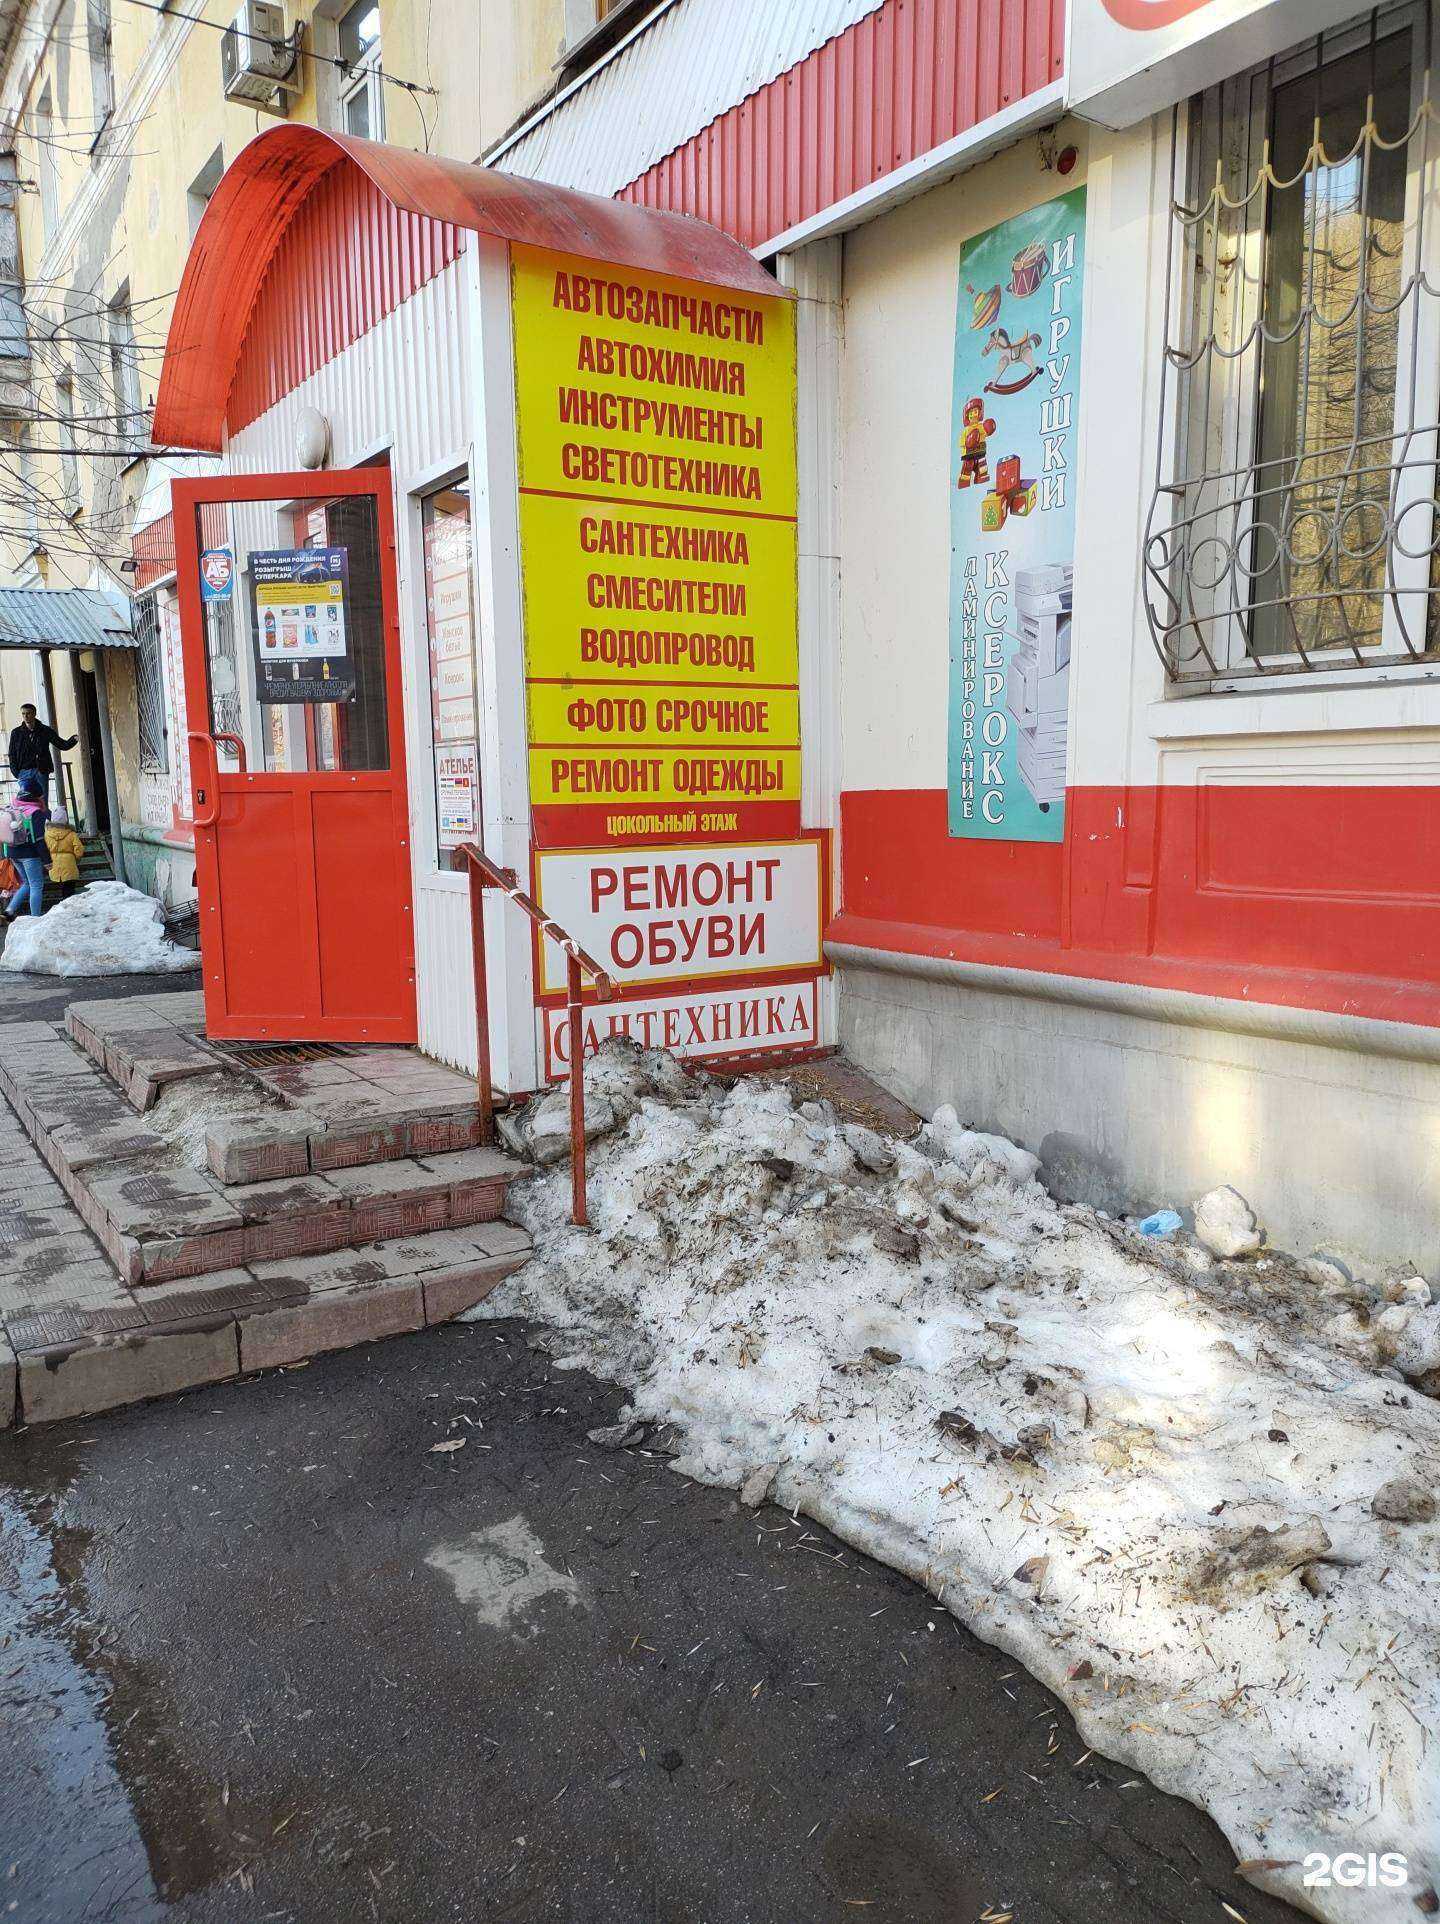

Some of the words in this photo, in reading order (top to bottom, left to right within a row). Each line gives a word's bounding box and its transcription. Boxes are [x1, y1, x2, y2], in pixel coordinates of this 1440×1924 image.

[552, 271, 764, 346] АВТОЗАПЧАСТИ
[577, 335, 746, 397] АВТОХИМИЯ
[1039, 232, 1077, 512] ИГРУШКИ
[558, 386, 763, 450] ИНСТРУМЕНТЫ
[561, 443, 762, 500] СВЕТОТЕХНИКА
[579, 517, 750, 565] САНТЕХНИКА
[206, 561, 229, 578] АБ
[587, 573, 747, 617] СМЕСИТЕЛИ
[580, 628, 755, 672] ВОДОПРОВОД
[961, 556, 978, 819] ЛАМИНИРОВАНИЕ
[980, 550, 1010, 825] КСЕРОКС
[567, 698, 647, 732] ФОТО
[656, 700, 769, 733] СРОЧНОЕ
[439, 757, 474, 775] АТЕЛЬЕ
[551, 759, 664, 793] РЕМОНТ
[673, 759, 784, 796] ОДЕЖДЫ
[606, 810, 697, 837] ЦОКОЛЬНЫЙ
[701, 812, 738, 832] ЭТАЖ
[590, 859, 781, 913] РЕМОНТ
[610, 912, 766, 969] ОБУВИ
